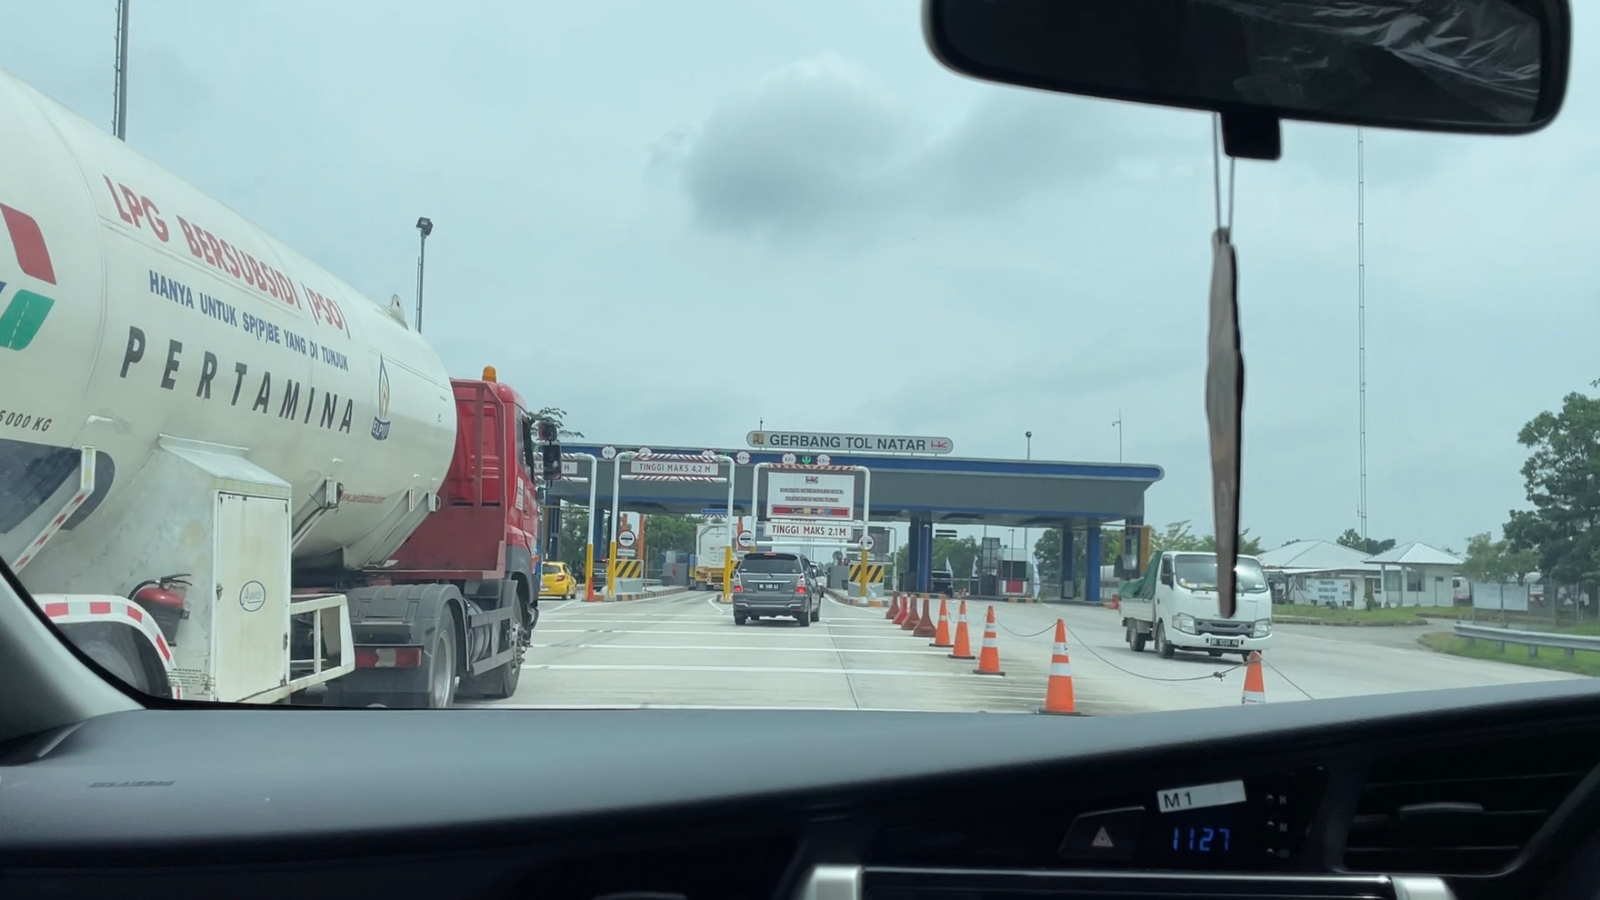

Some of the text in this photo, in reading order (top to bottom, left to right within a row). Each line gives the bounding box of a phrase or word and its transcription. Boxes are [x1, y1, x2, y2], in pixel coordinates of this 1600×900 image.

[102, 173, 351, 340] LPG BERSUBSIDI (PSO)
[148, 269, 349, 372] HANYA UNTUK SP(P)BE YANG DI TUNJUK
[119, 325, 354, 435] PERTAMINA
[31, 416, 52, 432] KG
[769, 434, 841, 449] GERBANG
[845, 436, 872, 450] TOL
[877, 438, 926, 451] NATAR
[639, 463, 665, 472] TINGGI
[667, 464, 689, 472] MAKS
[704, 465, 711, 473] M
[771, 525, 799, 534] TINGGI
[803, 526, 825, 535] MAKS
